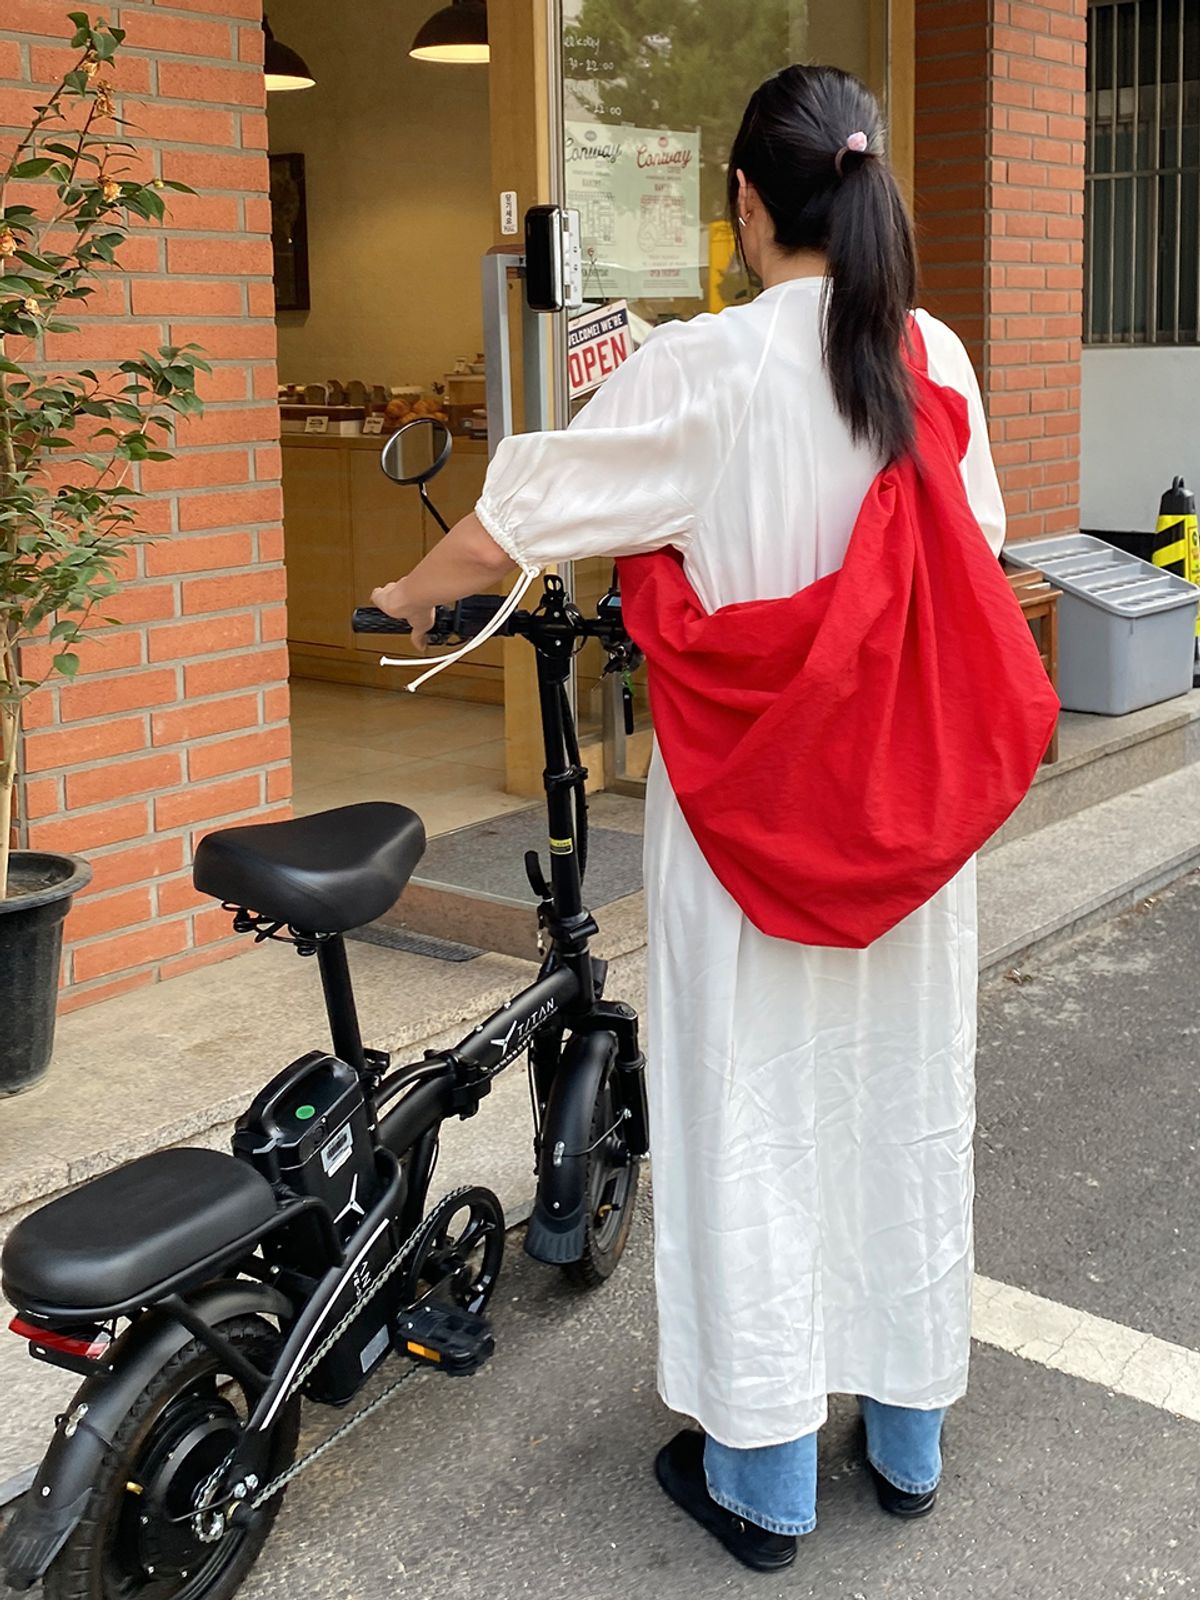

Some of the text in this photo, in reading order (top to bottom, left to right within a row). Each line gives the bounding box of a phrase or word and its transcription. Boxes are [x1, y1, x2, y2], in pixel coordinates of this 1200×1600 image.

[636, 144, 693, 169] Conway
[567, 332, 628, 389] OPEN
[517, 997, 554, 1036] TITAN
